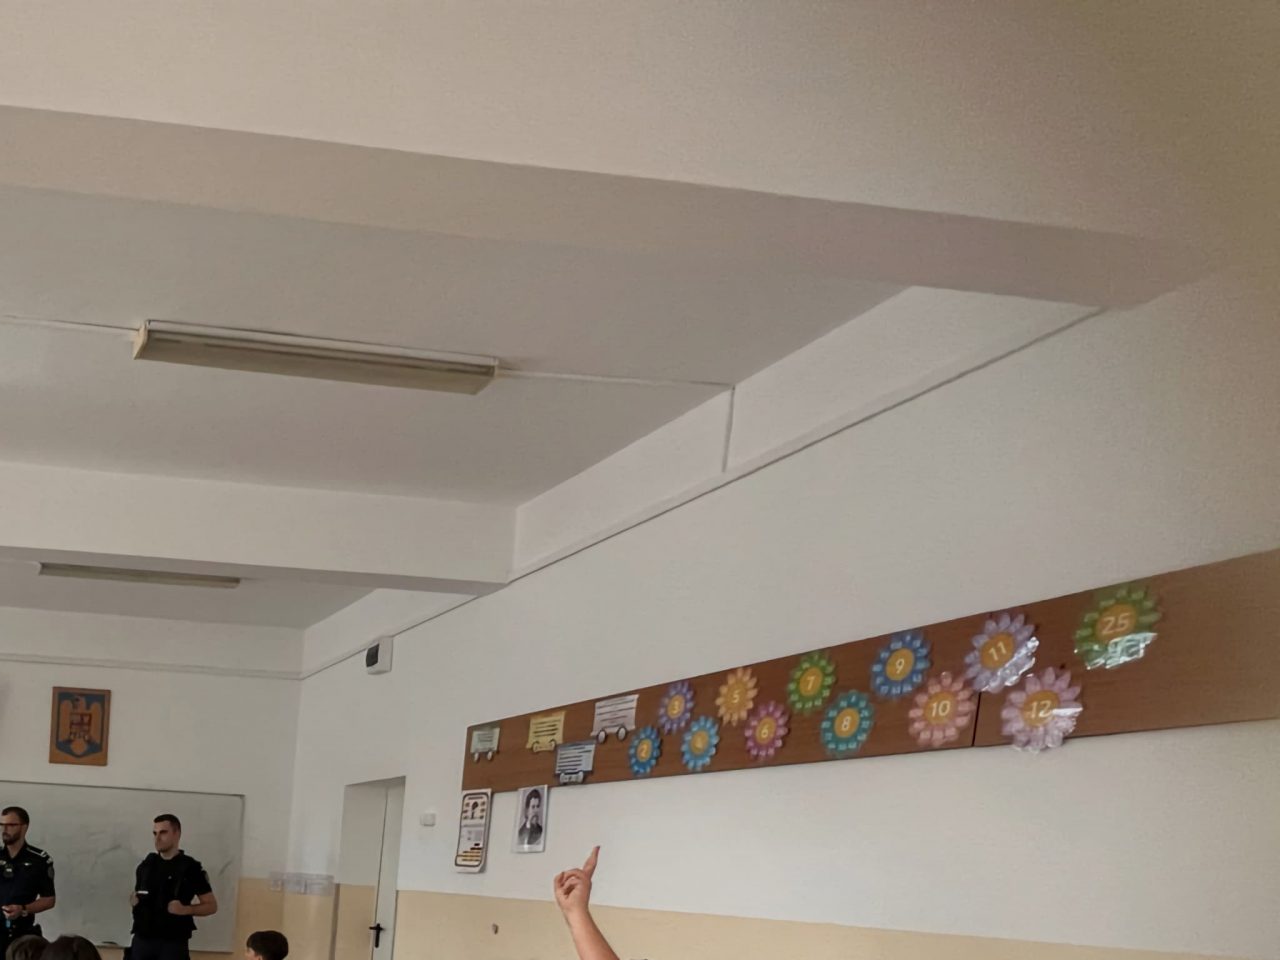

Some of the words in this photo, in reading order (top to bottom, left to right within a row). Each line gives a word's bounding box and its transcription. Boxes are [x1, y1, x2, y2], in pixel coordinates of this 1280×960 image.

[1101, 611, 1132, 635] 25
[988, 641, 1008, 661] 11
[895, 658, 905, 674] 9
[806, 676, 816, 690] 7
[732, 690, 741, 703] 5
[930, 700, 951, 718] 10
[1029, 699, 1053, 719] 12
[761, 724, 770, 738] 6
[841, 716, 851, 730] 8
